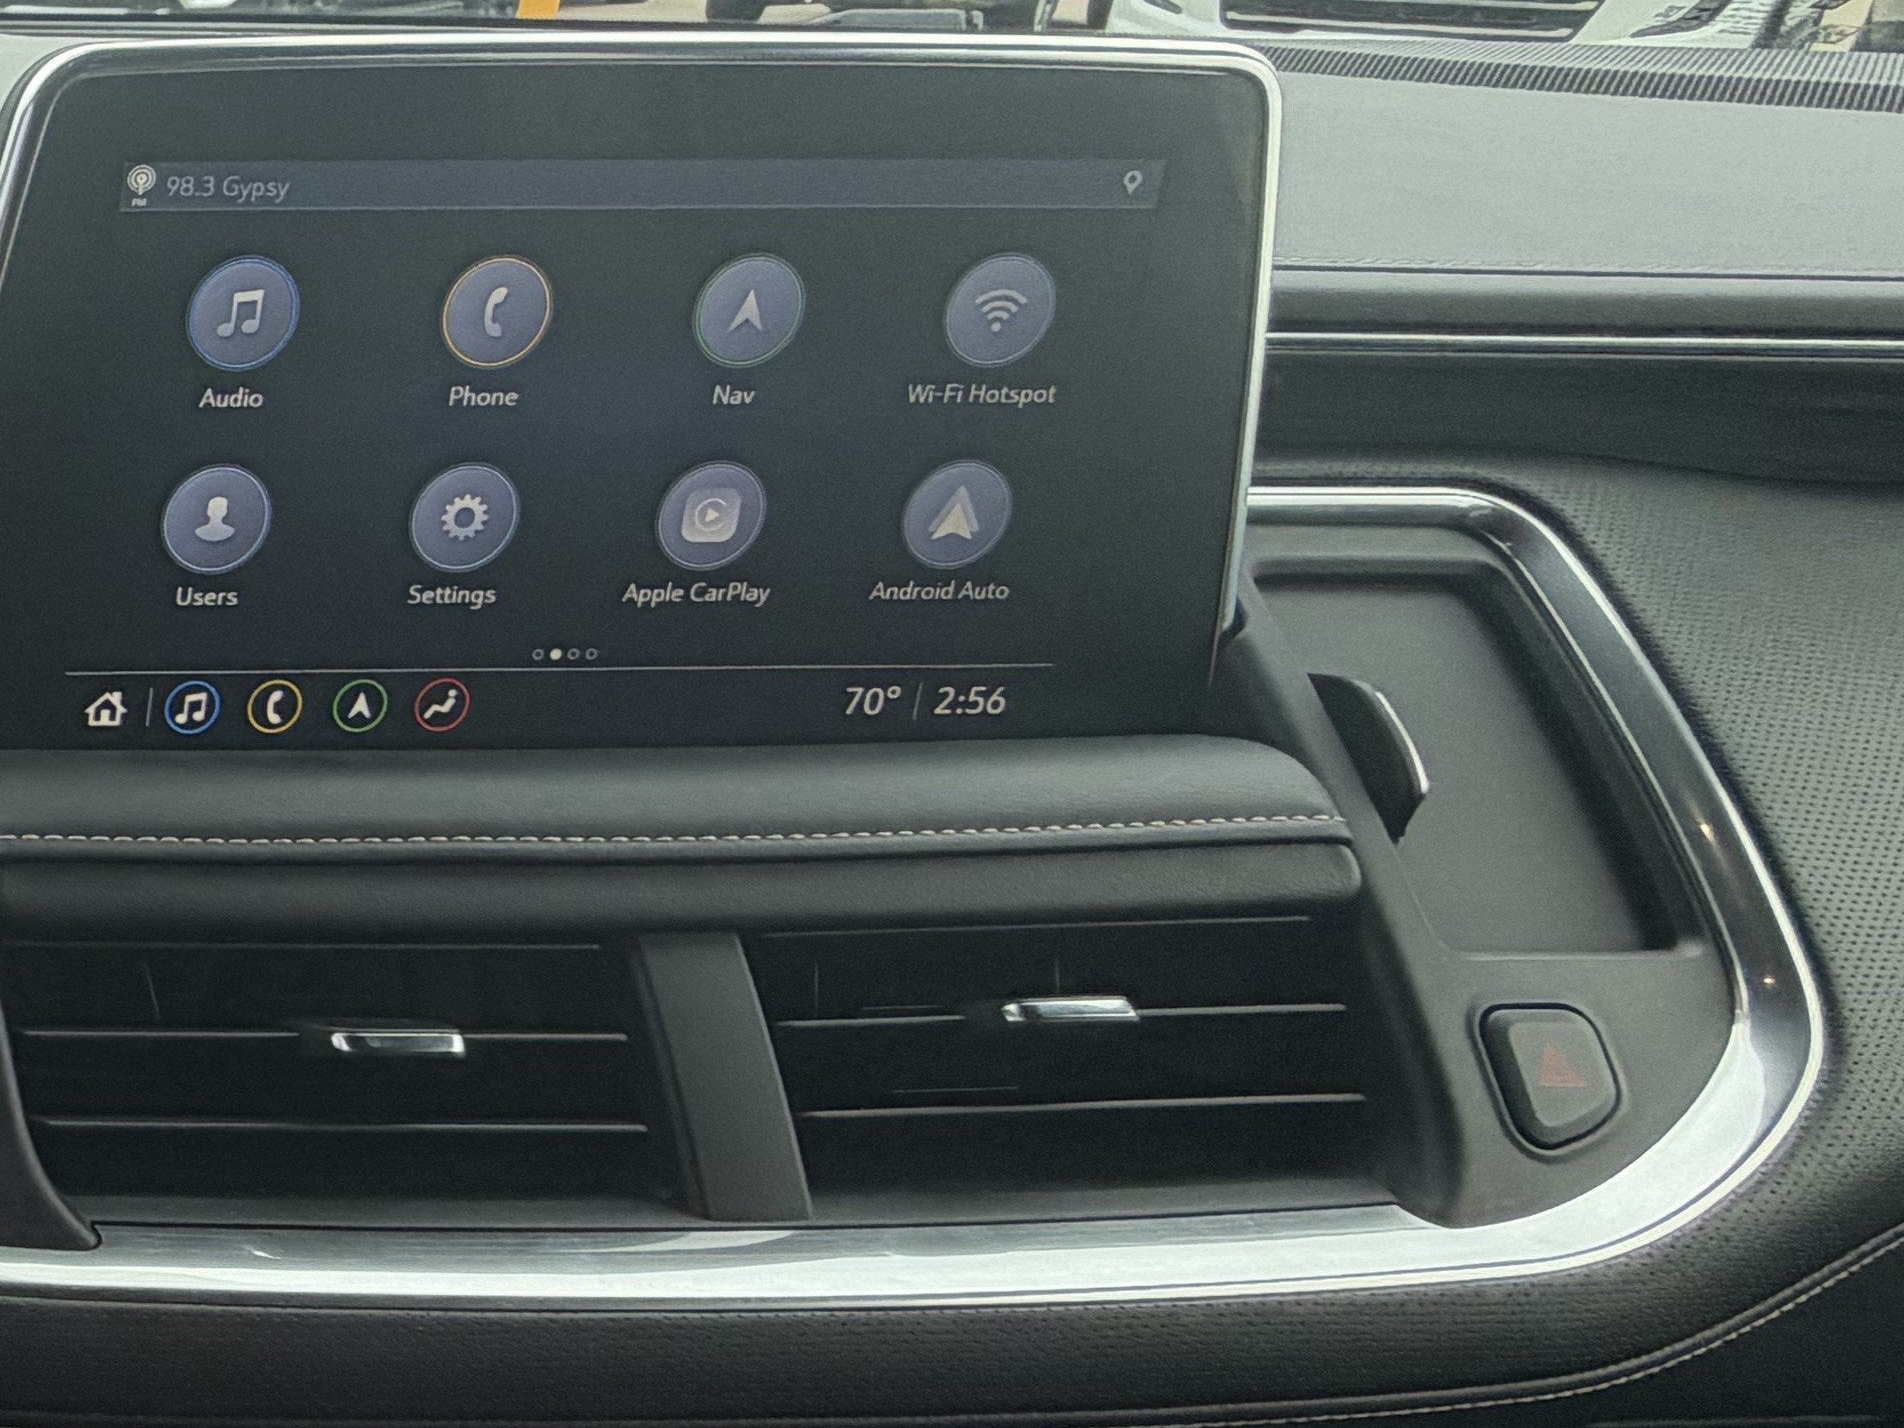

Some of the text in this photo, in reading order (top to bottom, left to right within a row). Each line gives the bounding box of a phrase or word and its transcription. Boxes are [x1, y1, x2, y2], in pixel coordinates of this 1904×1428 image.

[165, 175, 291, 204] 98.3 Gypsy
[198, 387, 264, 410] Audio
[448, 386, 519, 408] Phone
[711, 385, 755, 406] Nav
[907, 383, 1057, 409] Wi-Fi Hotspot
[175, 586, 239, 608] Users
[407, 584, 497, 610] Settings
[621, 582, 771, 607] Apple CarPlay
[868, 579, 1010, 601] Android Auto
[845, 685, 903, 716] 70°
[932, 685, 1007, 715] 2:56
